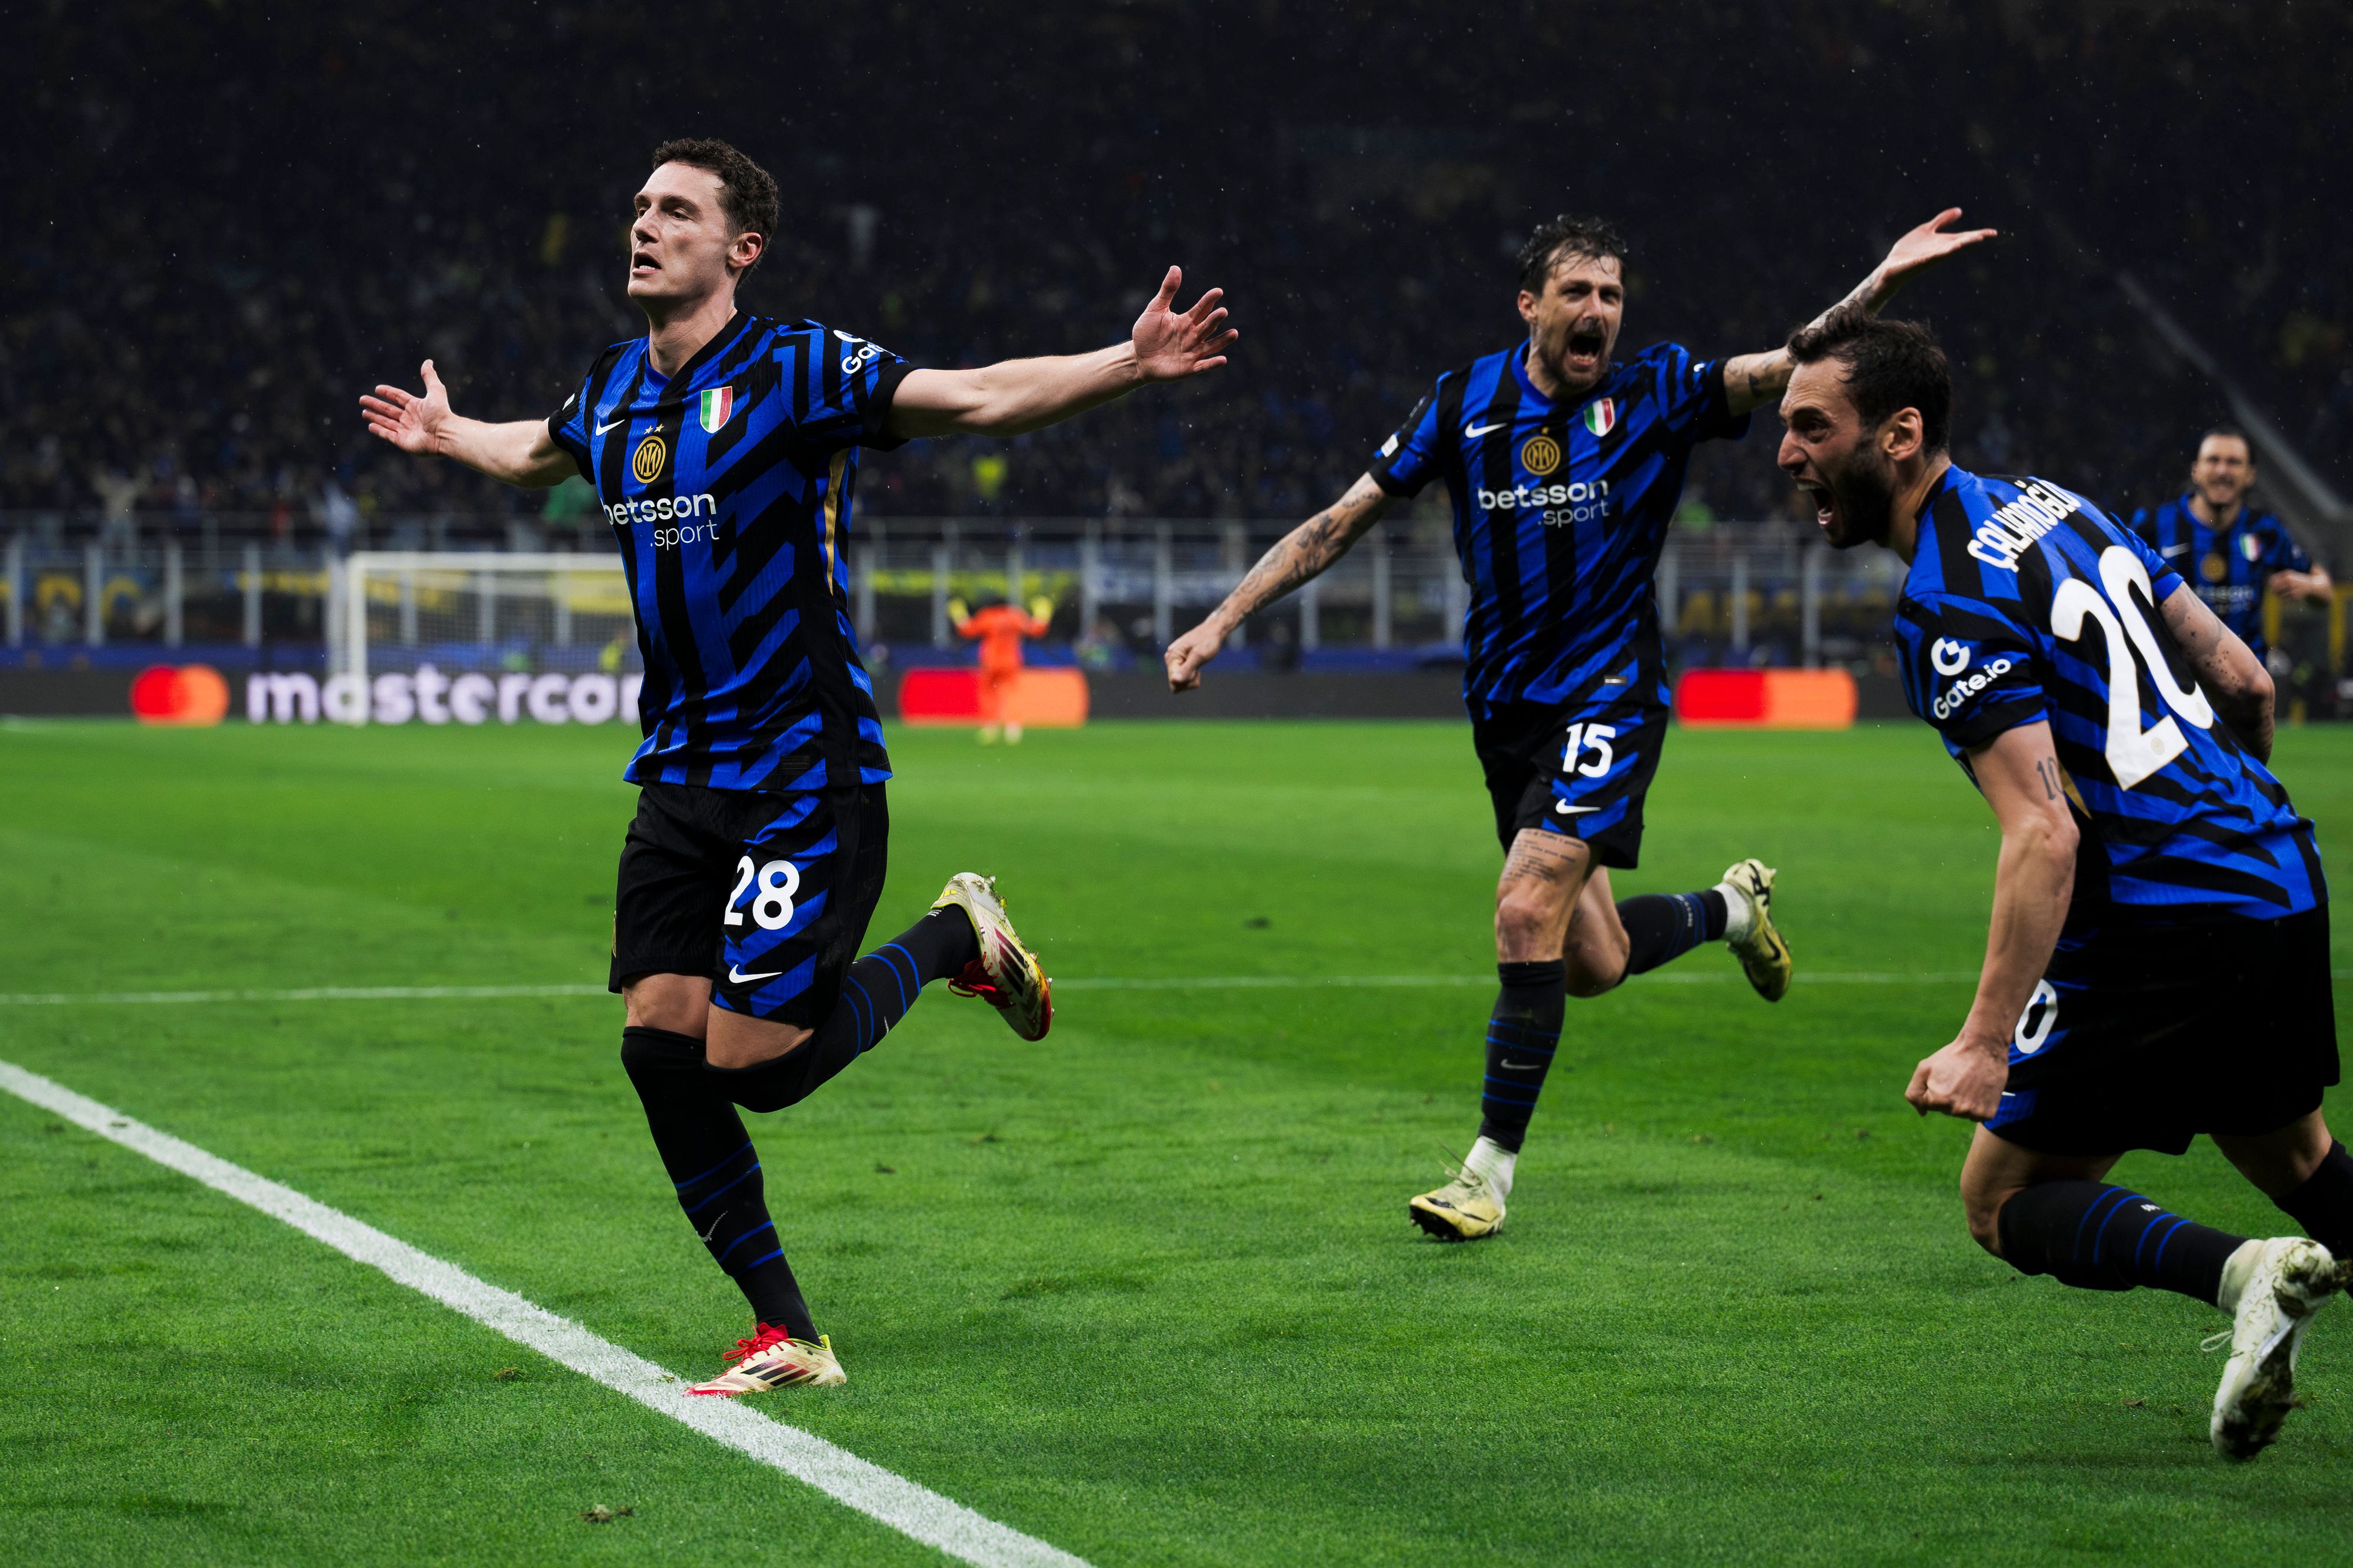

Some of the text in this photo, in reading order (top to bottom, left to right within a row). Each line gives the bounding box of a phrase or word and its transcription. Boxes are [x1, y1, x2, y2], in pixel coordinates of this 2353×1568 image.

[601, 493, 716, 525] betsson
[1478, 479, 1608, 510] betsson
[1537, 499, 1610, 528] .sport
[651, 519, 719, 551] .sport
[1934, 659, 2011, 719] Gate.io
[2051, 545, 2214, 792] 20
[1562, 722, 1616, 778] 15
[724, 855, 800, 930] 28
[2015, 978, 2058, 1054] 0
